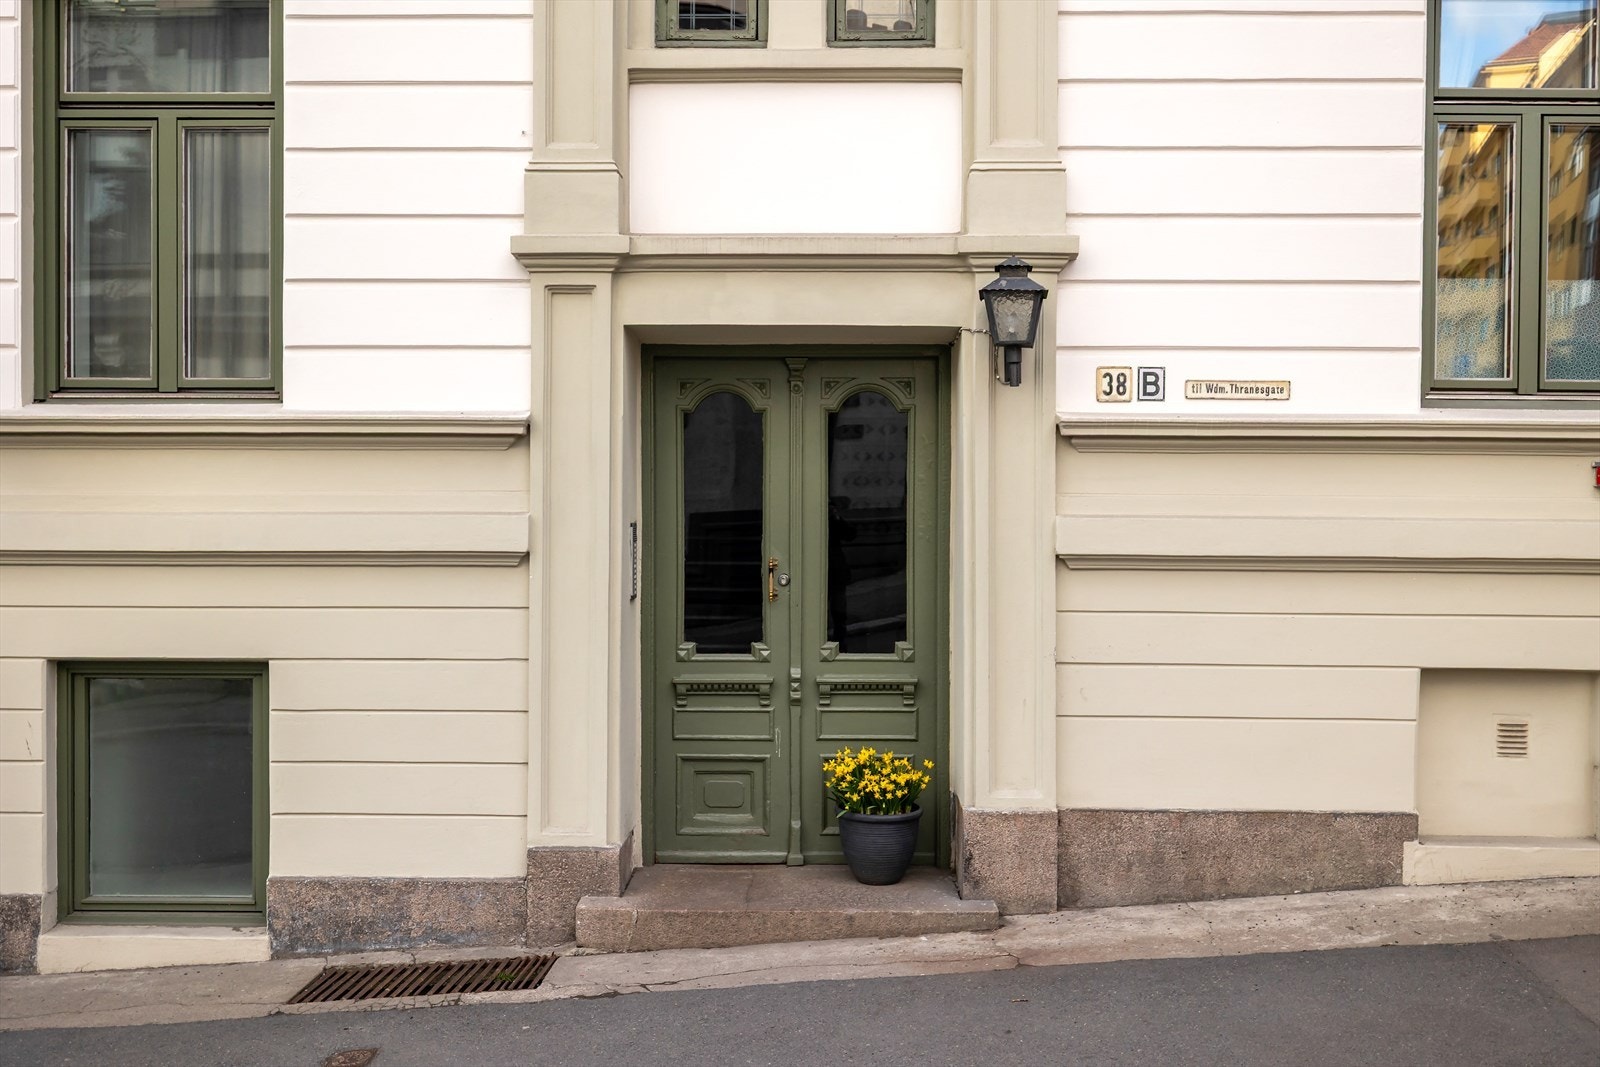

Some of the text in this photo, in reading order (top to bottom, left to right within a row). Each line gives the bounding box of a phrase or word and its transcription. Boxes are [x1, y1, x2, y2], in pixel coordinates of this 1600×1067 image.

[1102, 372, 1127, 396] 38
[1142, 371, 1160, 397] B
[1191, 383, 1203, 394] til
